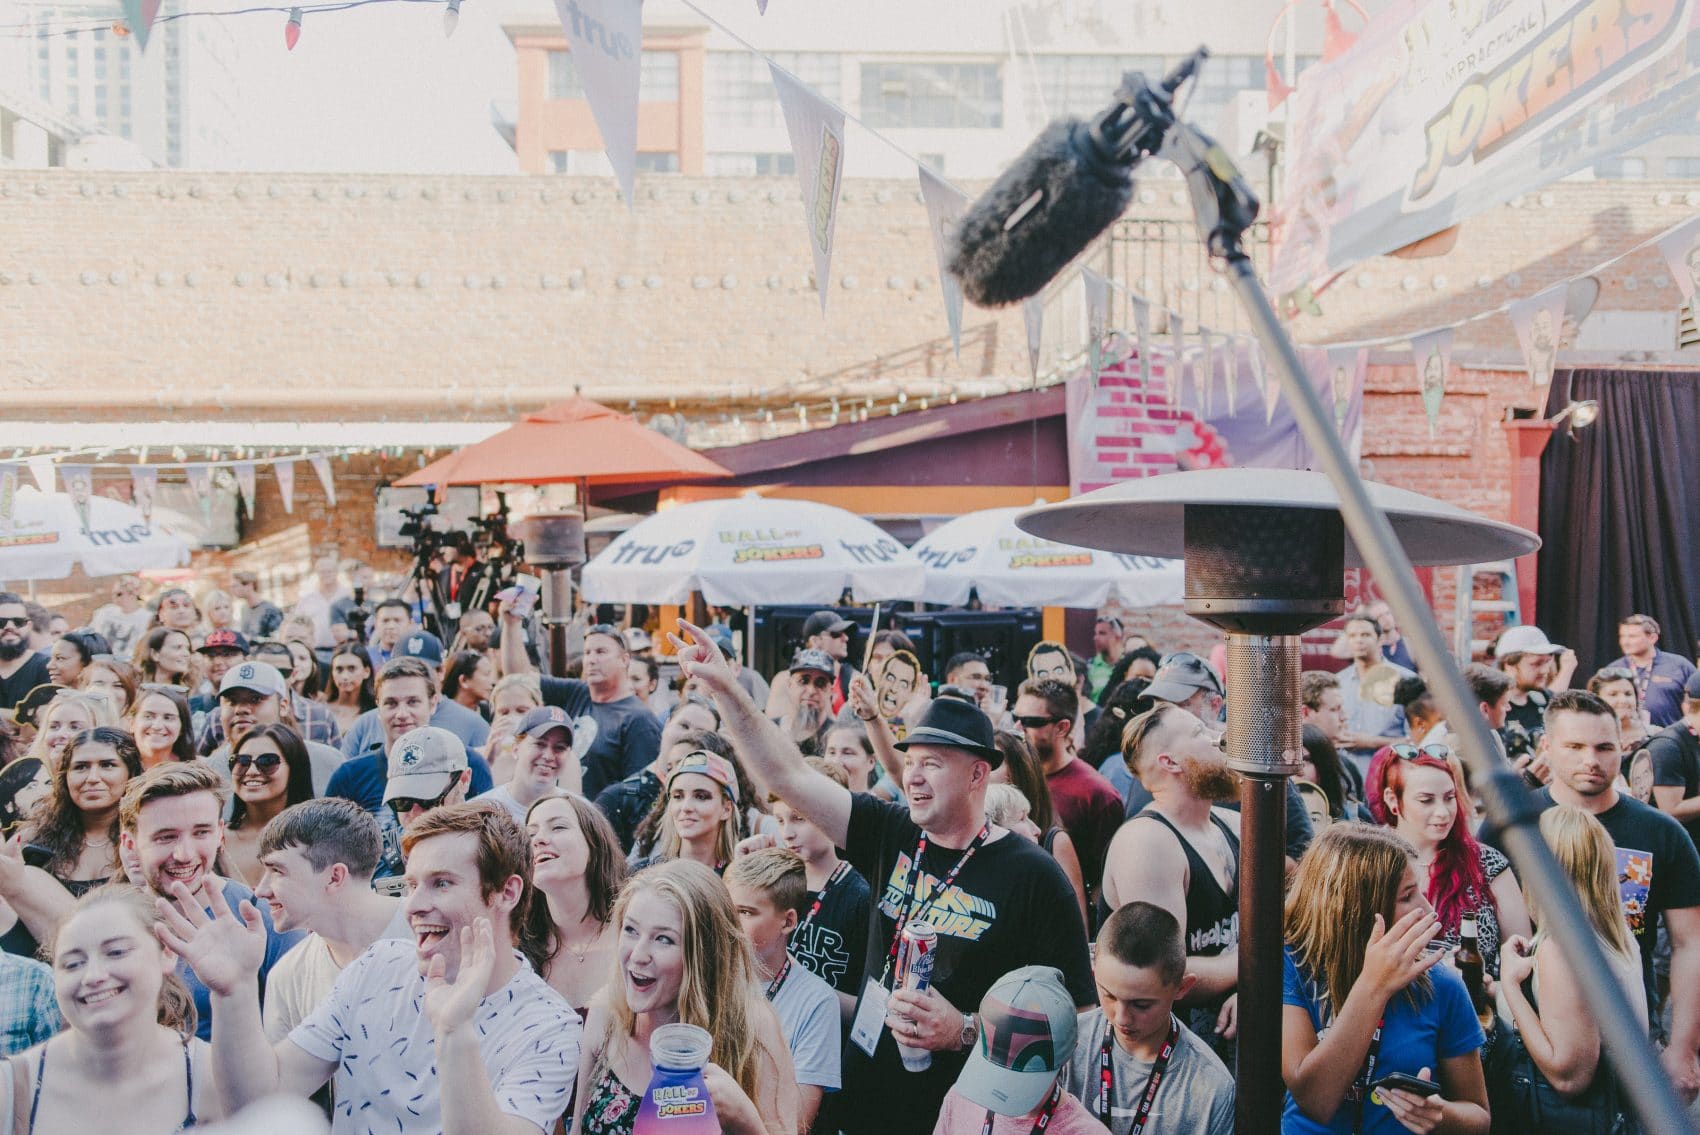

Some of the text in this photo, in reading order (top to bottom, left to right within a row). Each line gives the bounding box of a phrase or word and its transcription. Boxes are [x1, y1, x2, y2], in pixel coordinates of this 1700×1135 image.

[1409, 0, 1678, 201] JOKERS
[734, 544, 824, 564] JOKERS
[895, 900, 992, 941] TURE
[787, 921, 850, 963] AR
[659, 1102, 705, 1117] JOKERS
